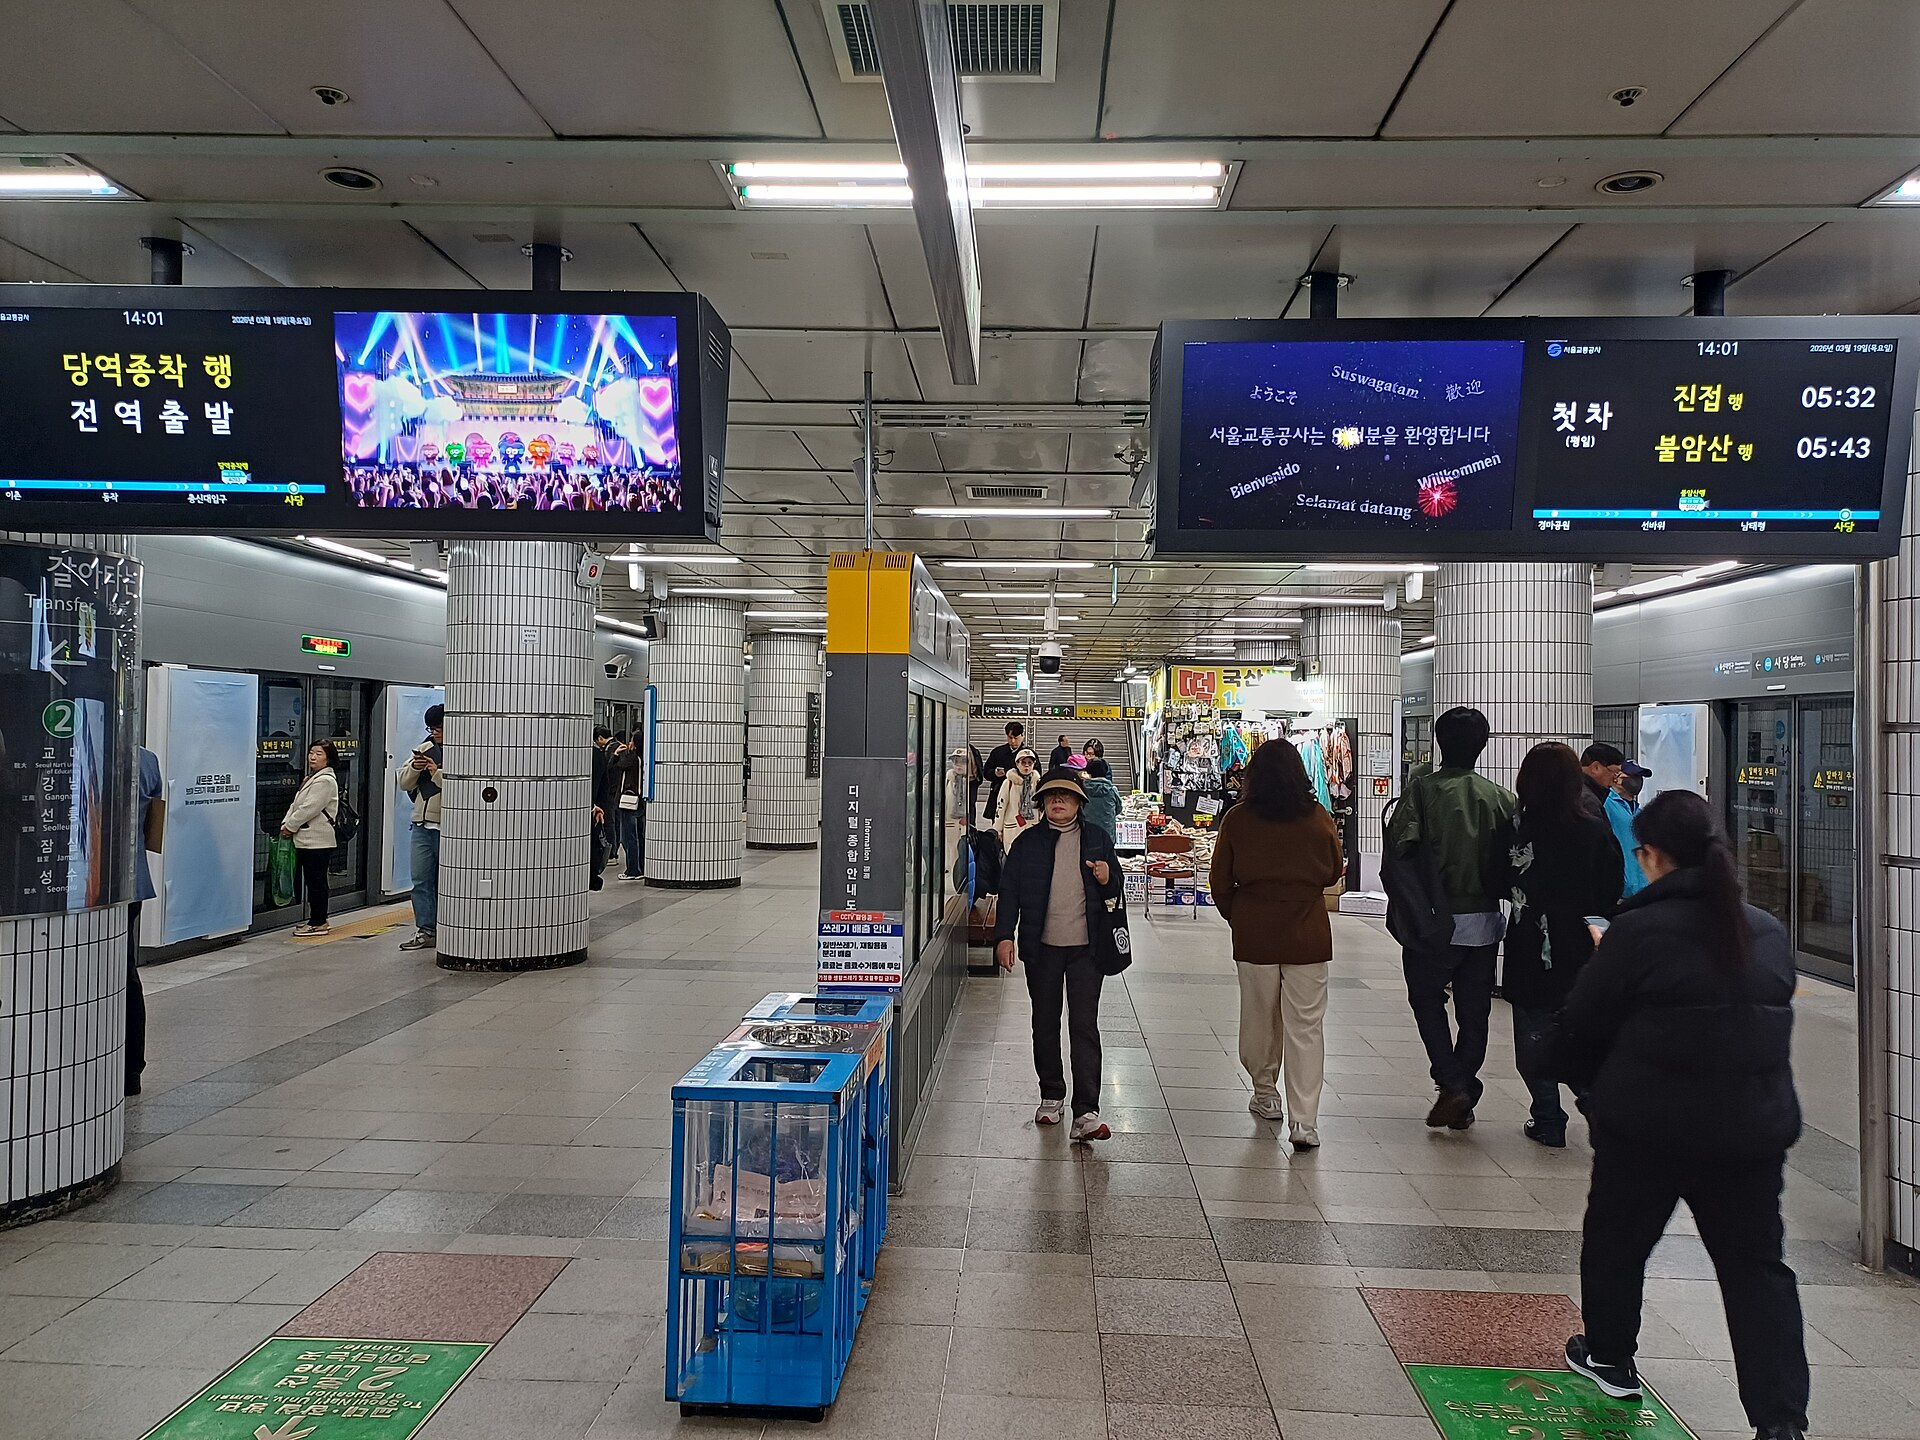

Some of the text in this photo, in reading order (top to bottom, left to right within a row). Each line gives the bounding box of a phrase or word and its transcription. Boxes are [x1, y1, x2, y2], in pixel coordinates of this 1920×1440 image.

[123, 311, 164, 326] 14:01
[1563, 346, 1601, 355] 서울교통공사
[1697, 341, 1739, 356] 14:01
[1810, 344, 1834, 353] 2026년
[63, 352, 233, 389] 당역종착 행
[1331, 365, 1420, 400] Suswagatam
[1249, 385, 1299, 406] ようこそ
[1673, 384, 1744, 412] 진접 행
[1801, 386, 1876, 409] 05:32
[1209, 426, 1326, 447] 서울교통공사는
[1404, 425, 1490, 446] 환영합니다
[1565, 434, 1596, 449] (평일)
[1655, 434, 1754, 463] 불암산 행
[1796, 437, 1871, 459] 05:43
[1417, 454, 1502, 491] Willkommen
[1229, 463, 1300, 500] Bienvenido
[102, 492, 119, 503] 동작
[1680, 488, 1706, 498] 불암산행
[284, 495, 304, 507] 사당
[1296, 494, 1413, 520] Selamat datang
[1537, 520, 1570, 531] 경마공원
[1641, 521, 1666, 532] 선바위
[1740, 521, 1766, 532] 남태령
[1834, 521, 1855, 533] 사당
[47, 556, 137, 597] 갈아타는
[24, 593, 95, 613] Transfer
[1774, 656, 1790, 670] 사당
[1178, 668, 1264, 706] 떡 국산
[55, 705, 72, 732] 2
[863, 818, 872, 861] Information
[846, 834, 859, 863] 종합
[845, 867, 858, 911] 안내도
[822, 924, 892, 934] 쓰레기 배출 안내
[822, 941, 858, 950] 일반쓰레기,
[822, 950, 837, 958] 분리
[336, 1344, 412, 1353] Transfer
[293, 1364, 361, 1377] Line
[357, 1366, 410, 1391] 2
[305, 1391, 386, 1400] Education
[215, 1401, 269, 1415] 방면
